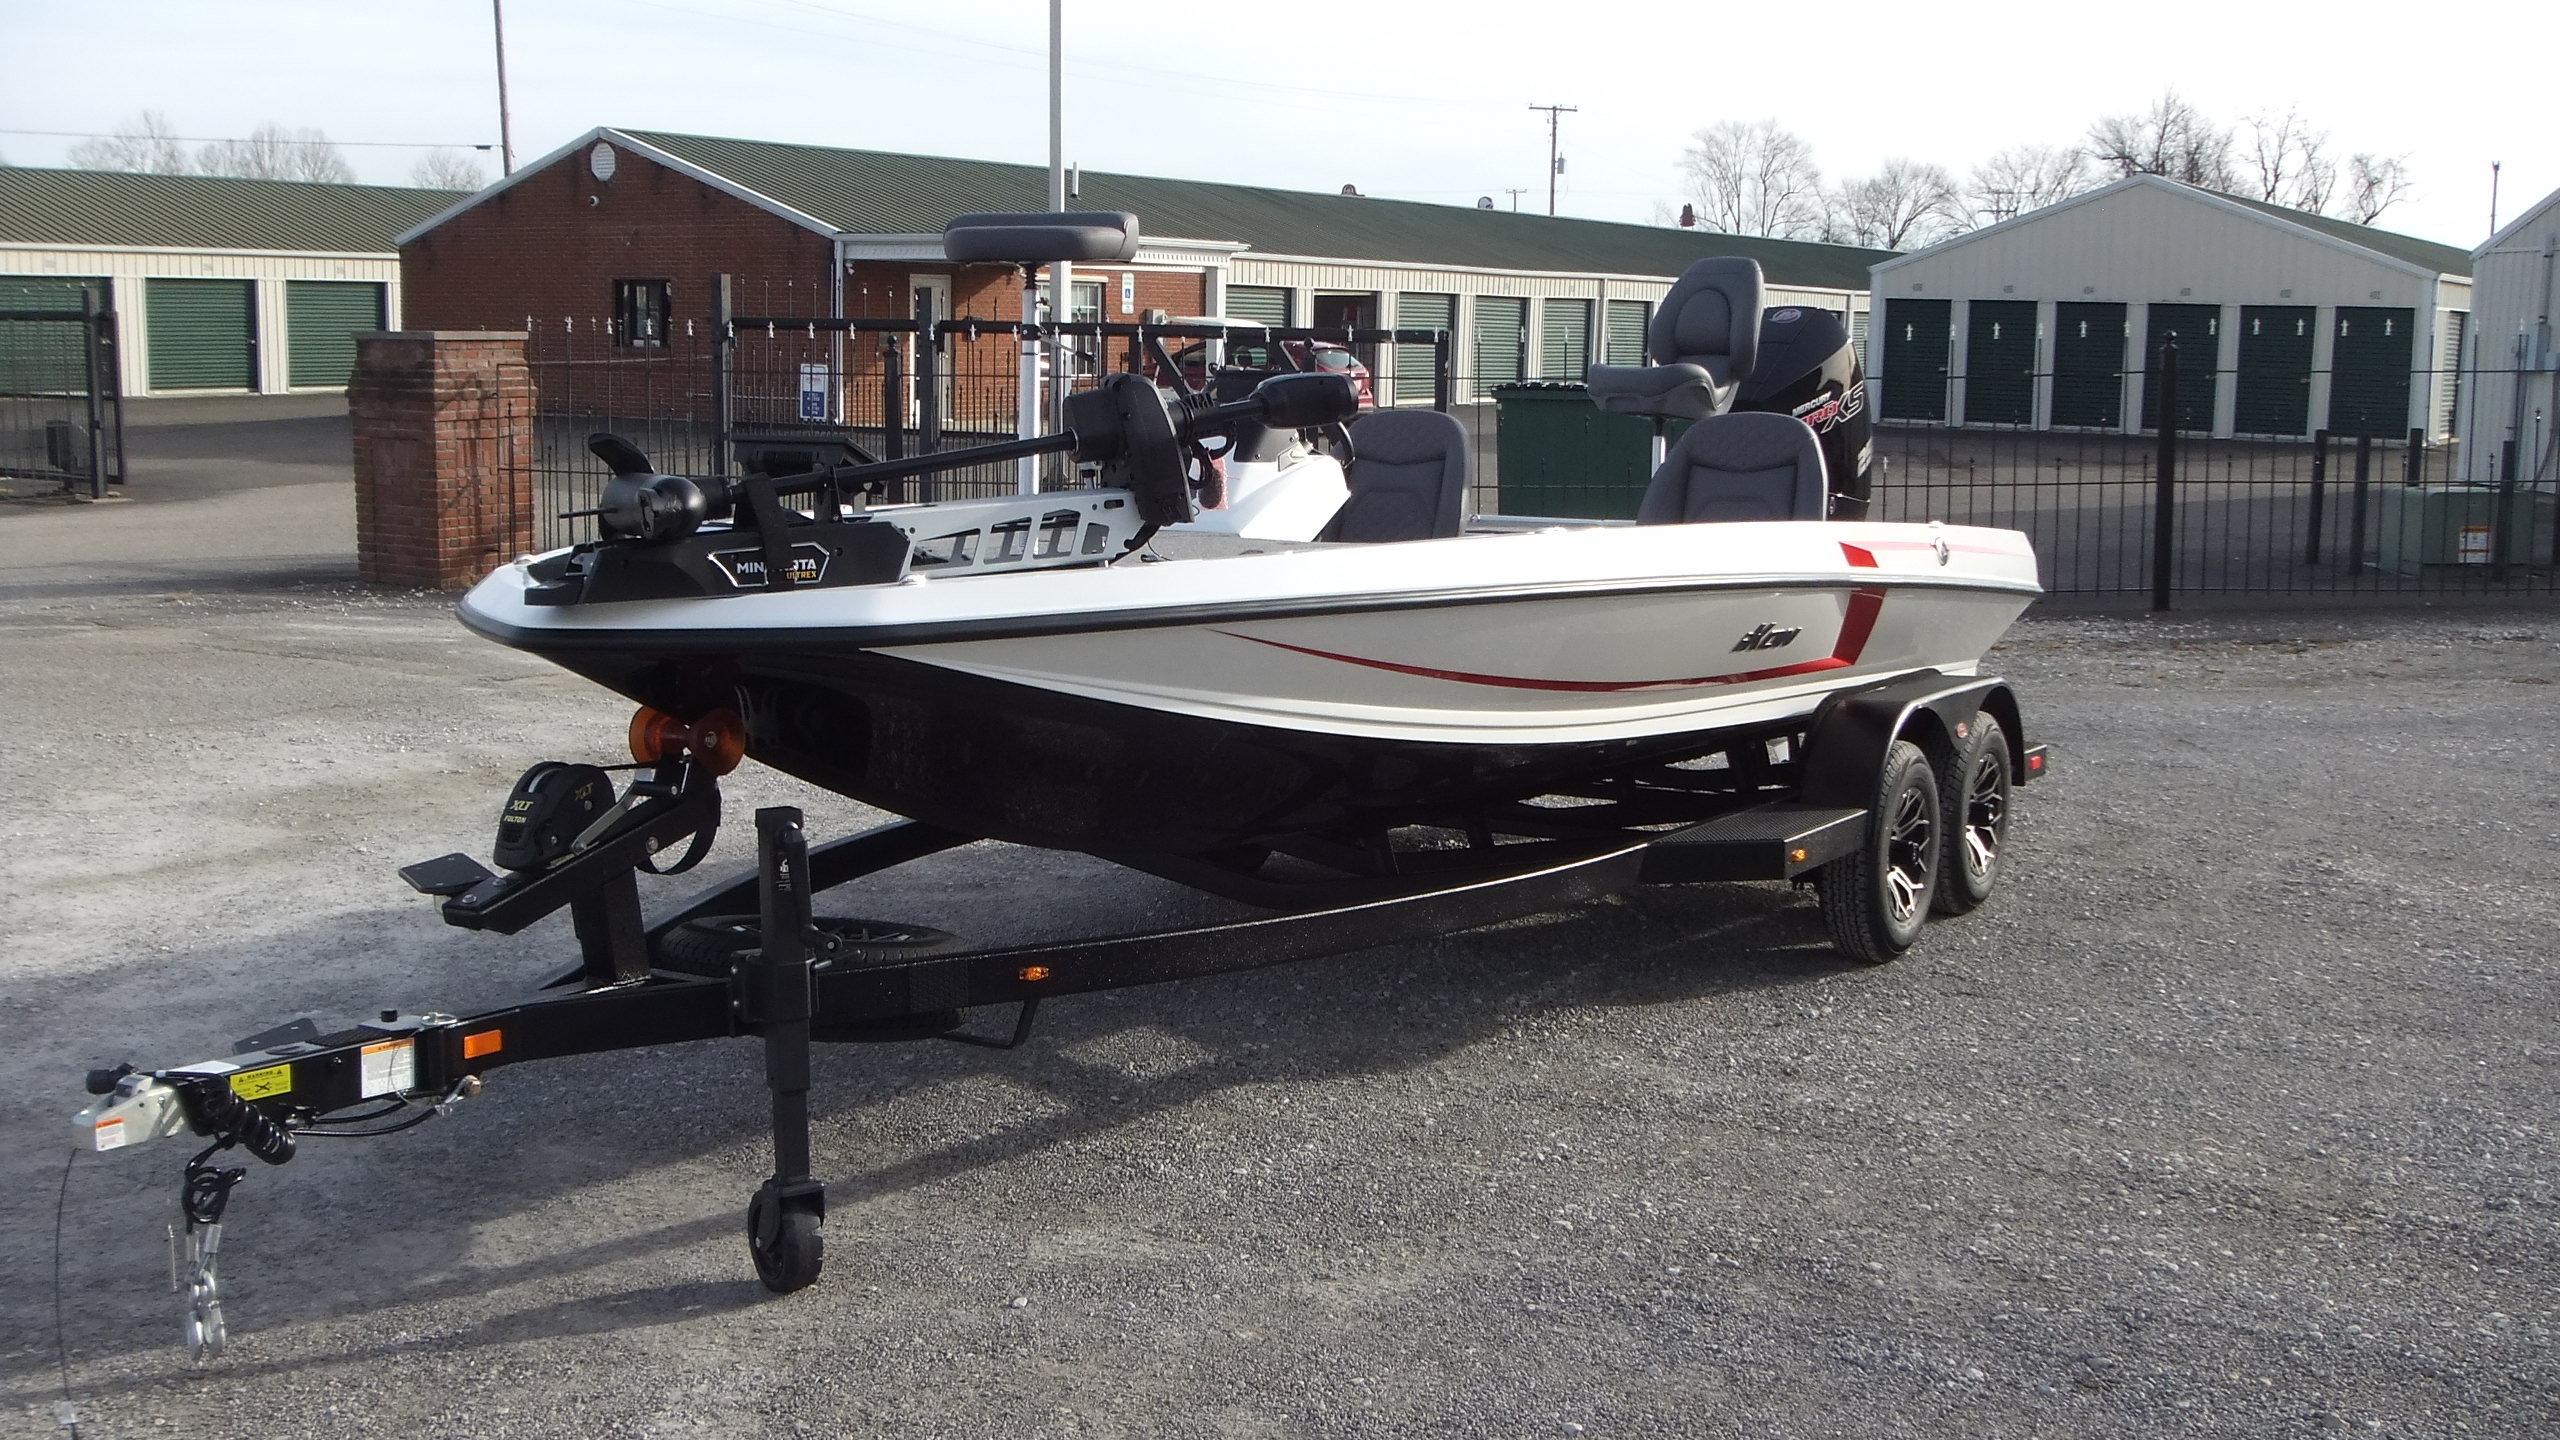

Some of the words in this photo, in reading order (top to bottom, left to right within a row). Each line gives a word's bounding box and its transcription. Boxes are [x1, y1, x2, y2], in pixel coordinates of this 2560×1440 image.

[1792, 391, 1832, 417] MERCURY
[736, 561, 765, 574] MIN
[510, 799, 534, 811] XLT
[503, 815, 527, 823] FULTON
